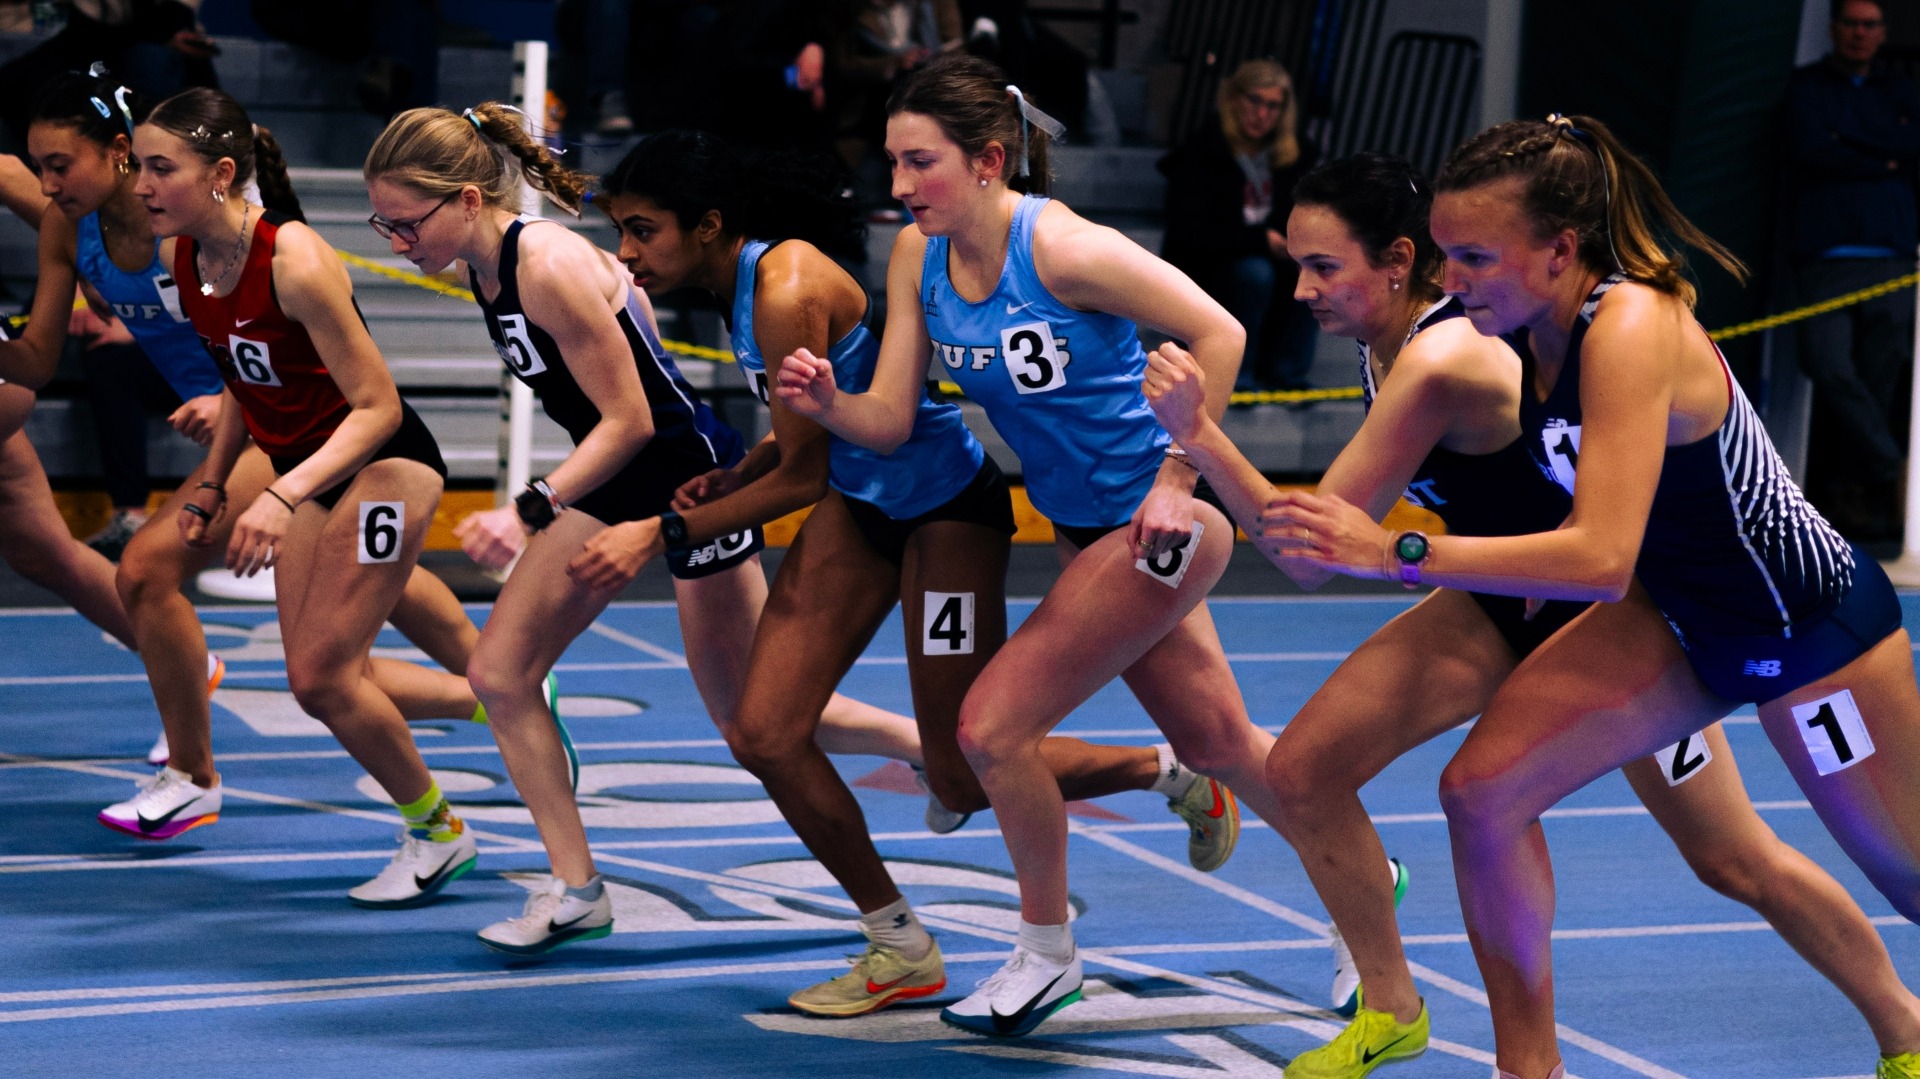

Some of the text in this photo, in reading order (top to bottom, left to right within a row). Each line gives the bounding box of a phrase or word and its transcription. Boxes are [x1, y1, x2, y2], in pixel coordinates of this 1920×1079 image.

[236, 342, 271, 382] 6
[500, 320, 532, 372] 5
[1010, 330, 1053, 389] 3
[364, 506, 398, 560] 6
[687, 544, 716, 567] NB
[929, 597, 967, 650] 4
[1743, 659, 1782, 677] NB
[1807, 702, 1854, 764] 1
